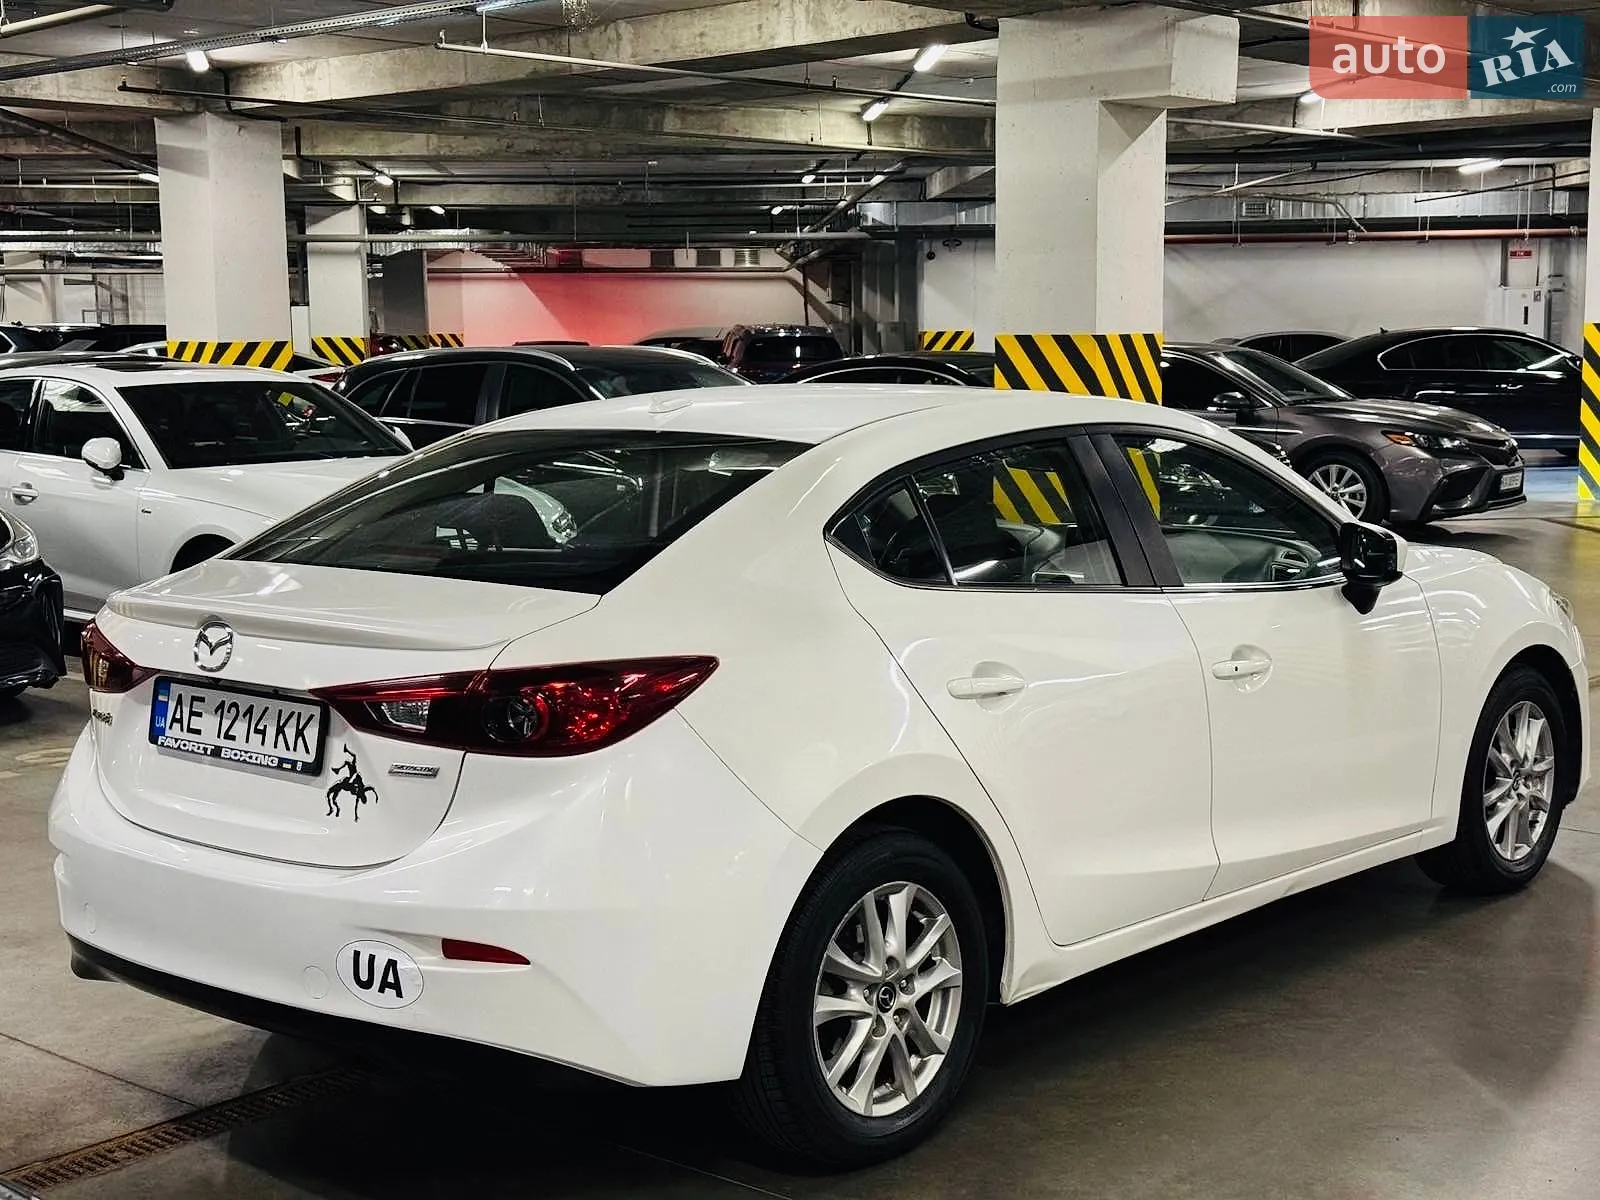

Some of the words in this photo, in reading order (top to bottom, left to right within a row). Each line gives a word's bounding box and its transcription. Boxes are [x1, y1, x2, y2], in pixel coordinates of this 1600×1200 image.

[155, 716, 165, 728] UA
[169, 693, 205, 735] AE
[214, 700, 270, 746] 1214
[157, 735, 214, 755] FAVORIT
[221, 748, 279, 768] BOXING
[352, 949, 403, 999] UA
